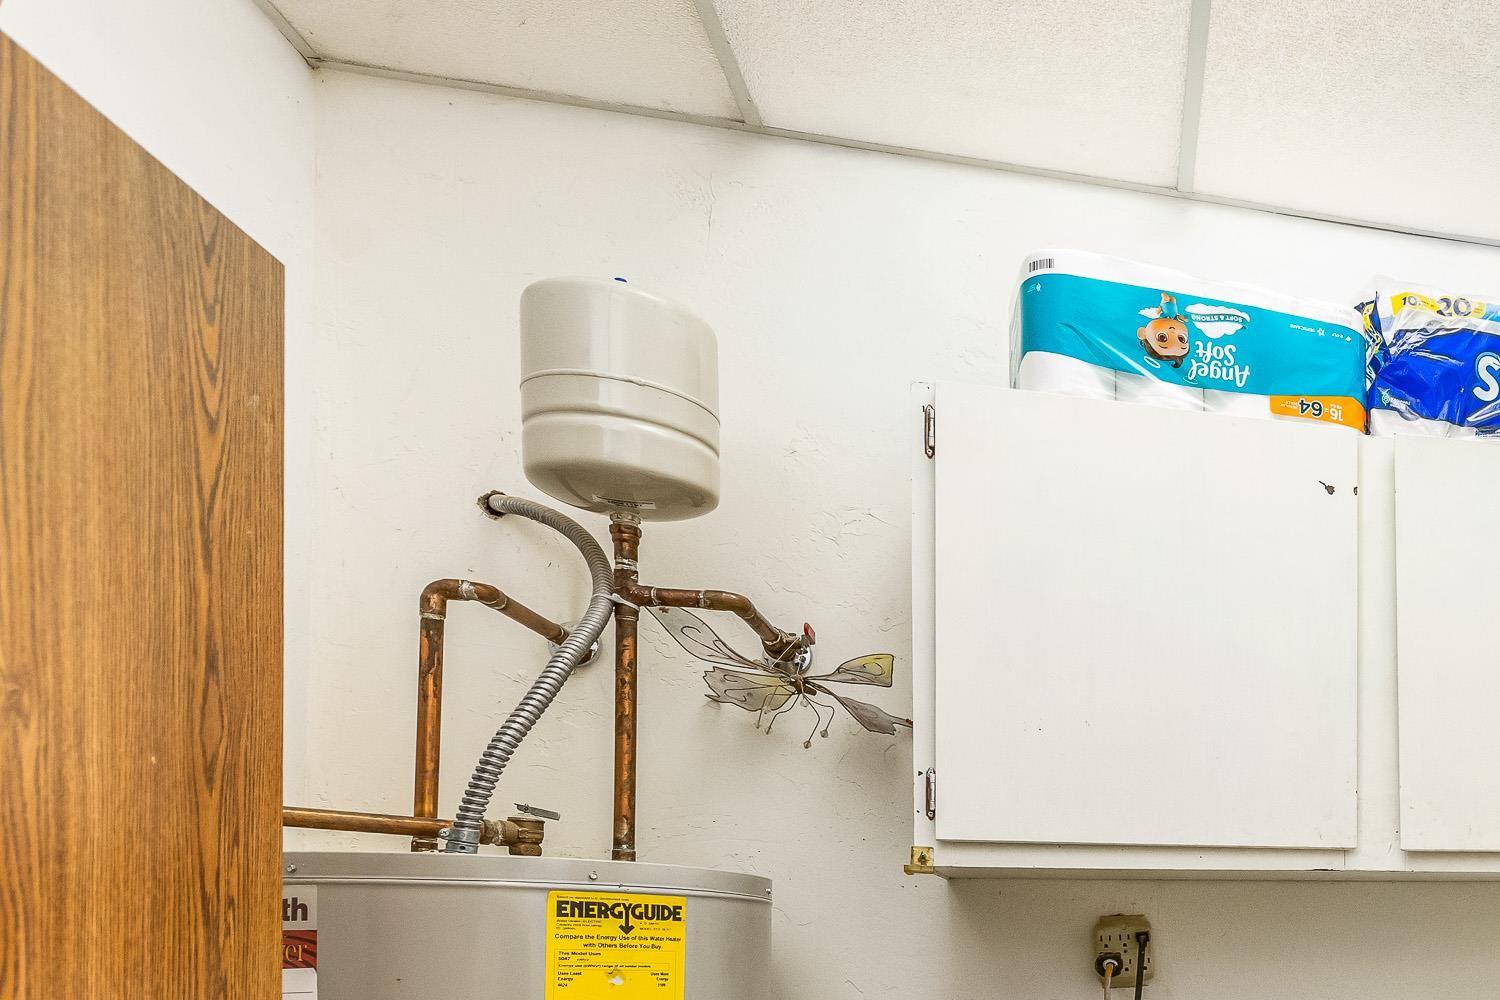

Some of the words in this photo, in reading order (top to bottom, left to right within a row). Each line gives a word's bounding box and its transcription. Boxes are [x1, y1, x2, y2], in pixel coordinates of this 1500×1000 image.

[1401, 296, 1417, 306] 10
[1437, 297, 1472, 317] 20
[1191, 313, 1219, 321] STRONG
[1226, 314, 1243, 323] SOFT
[1195, 340, 1236, 366] Soft
[1188, 359, 1250, 387] Angel
[1298, 398, 1323, 418] 64
[1330, 407, 1343, 421] 16
[556, 899, 683, 923] ENERGYGUIDE
[555, 933, 583, 941] Compare
[597, 934, 617, 942] Energy
